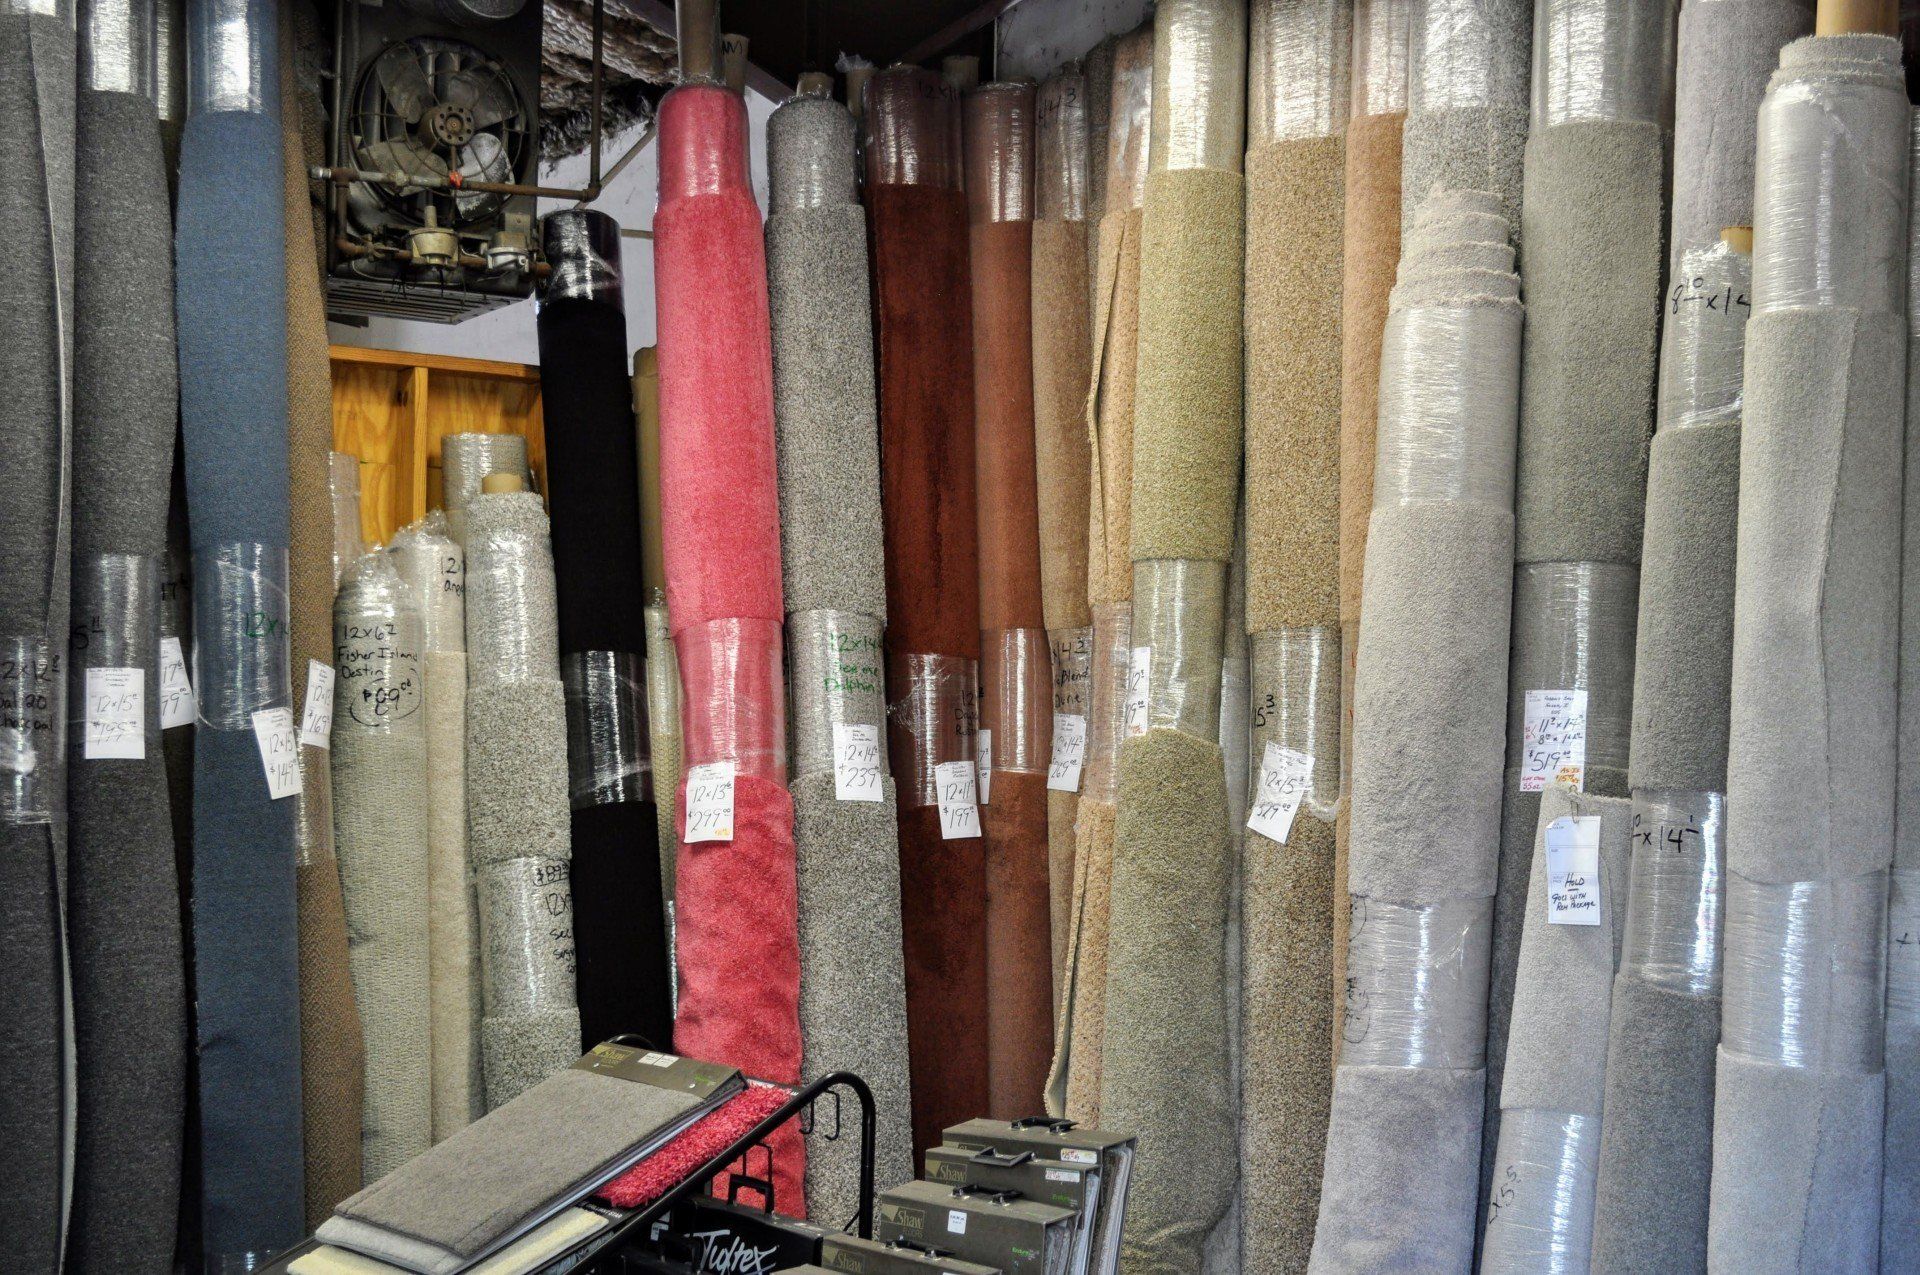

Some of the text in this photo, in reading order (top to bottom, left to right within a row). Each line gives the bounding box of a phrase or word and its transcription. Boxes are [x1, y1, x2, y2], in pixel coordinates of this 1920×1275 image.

[940, 1164, 966, 1181] Shaw
[898, 1209, 925, 1230] Shaw
[837, 1252, 865, 1273] Shaw
